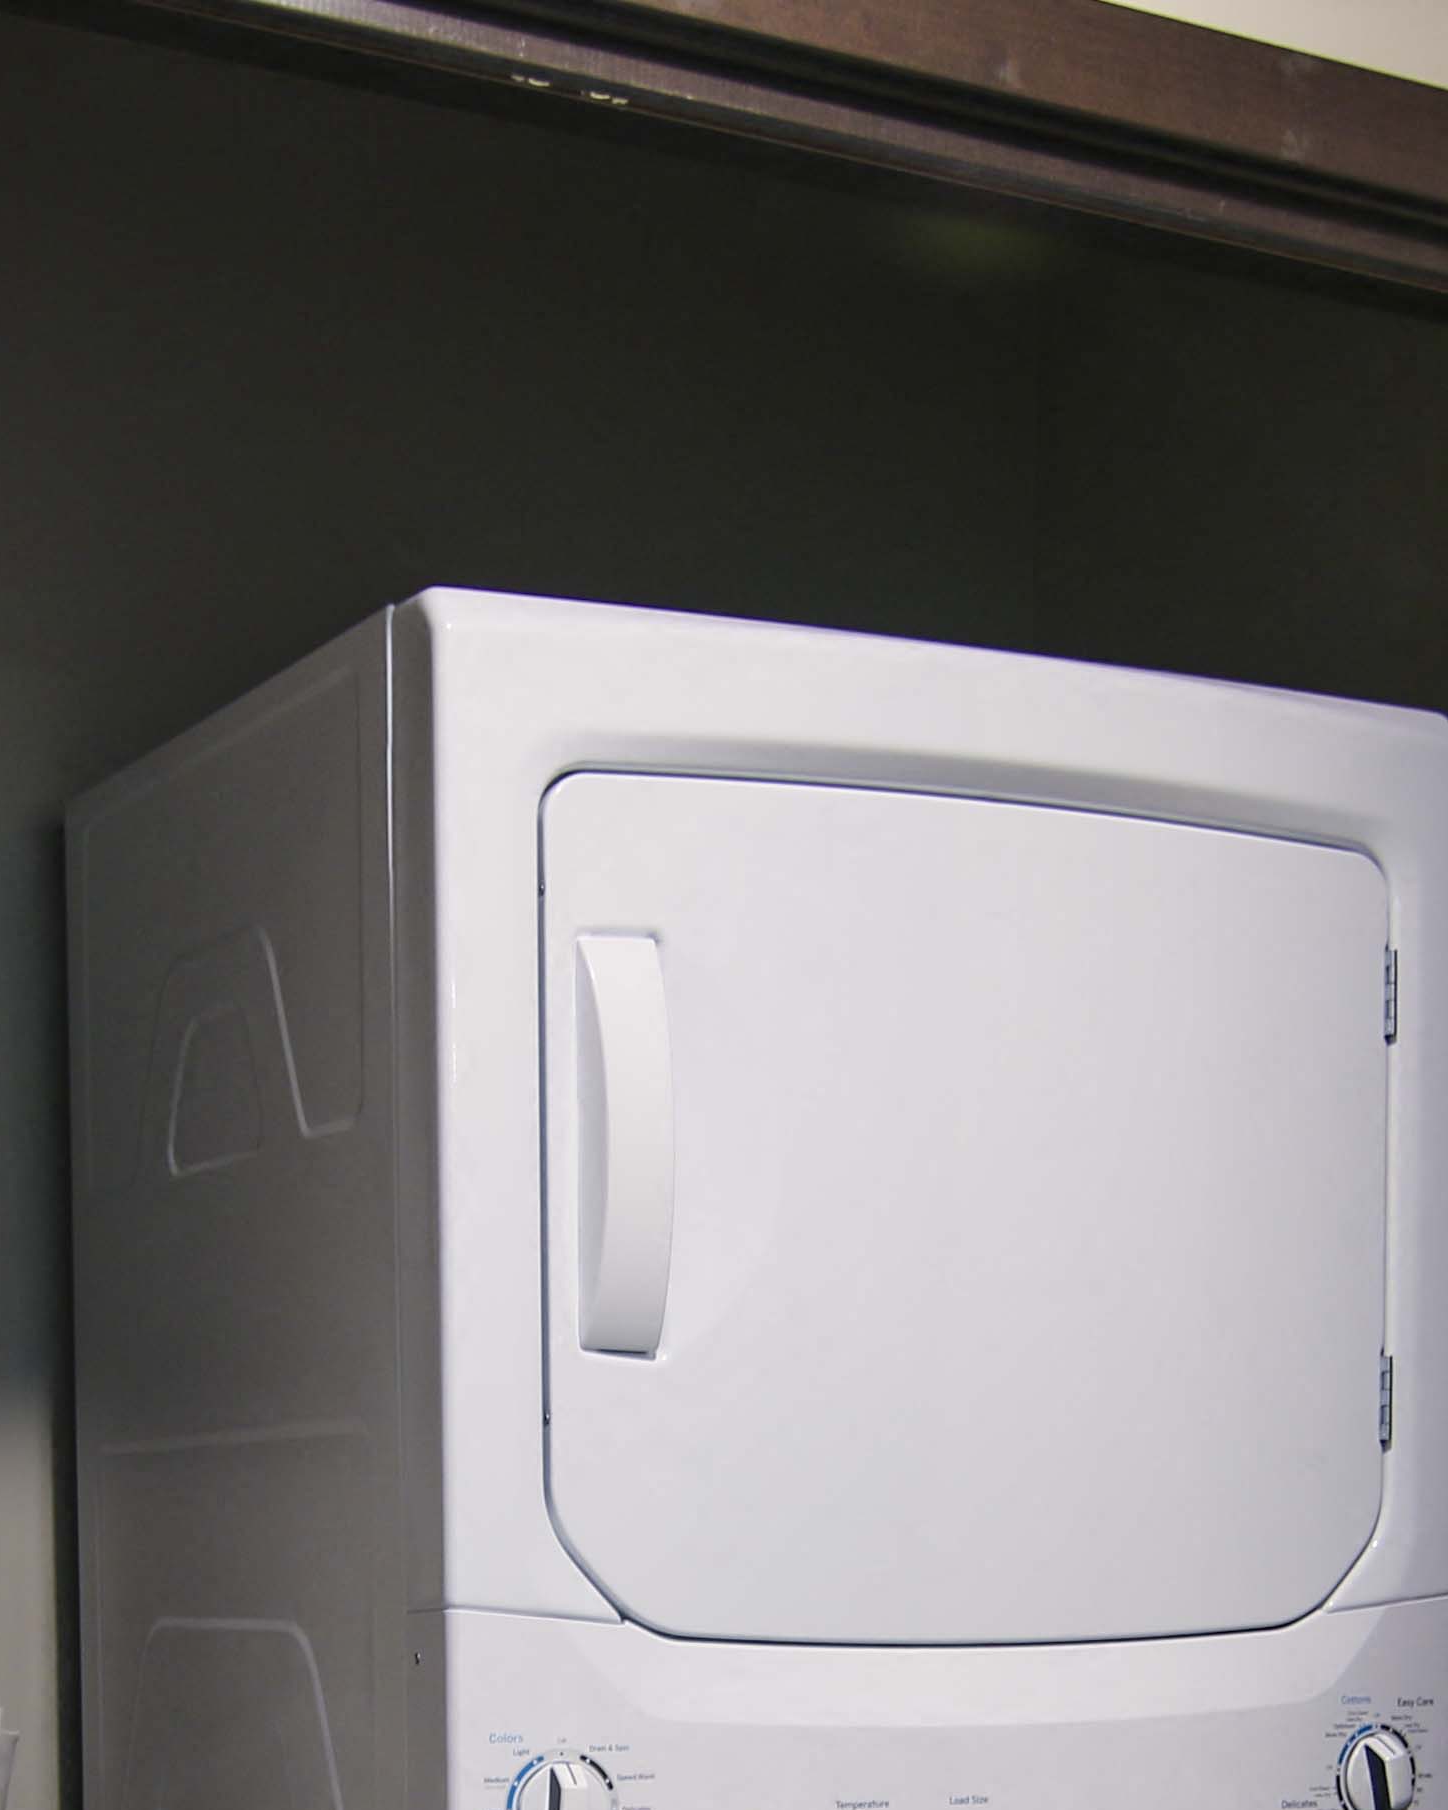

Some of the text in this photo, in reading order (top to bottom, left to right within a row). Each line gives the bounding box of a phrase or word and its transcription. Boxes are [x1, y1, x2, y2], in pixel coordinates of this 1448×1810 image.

[1397, 1697, 1434, 1708] Easy Care
[489, 1733, 523, 1744] Colors
[513, 1748, 530, 1757] Light
[835, 1800, 889, 1810] Temperature
[949, 1796, 988, 1805] Load Size
[1281, 1800, 1318, 1810] Delicates
